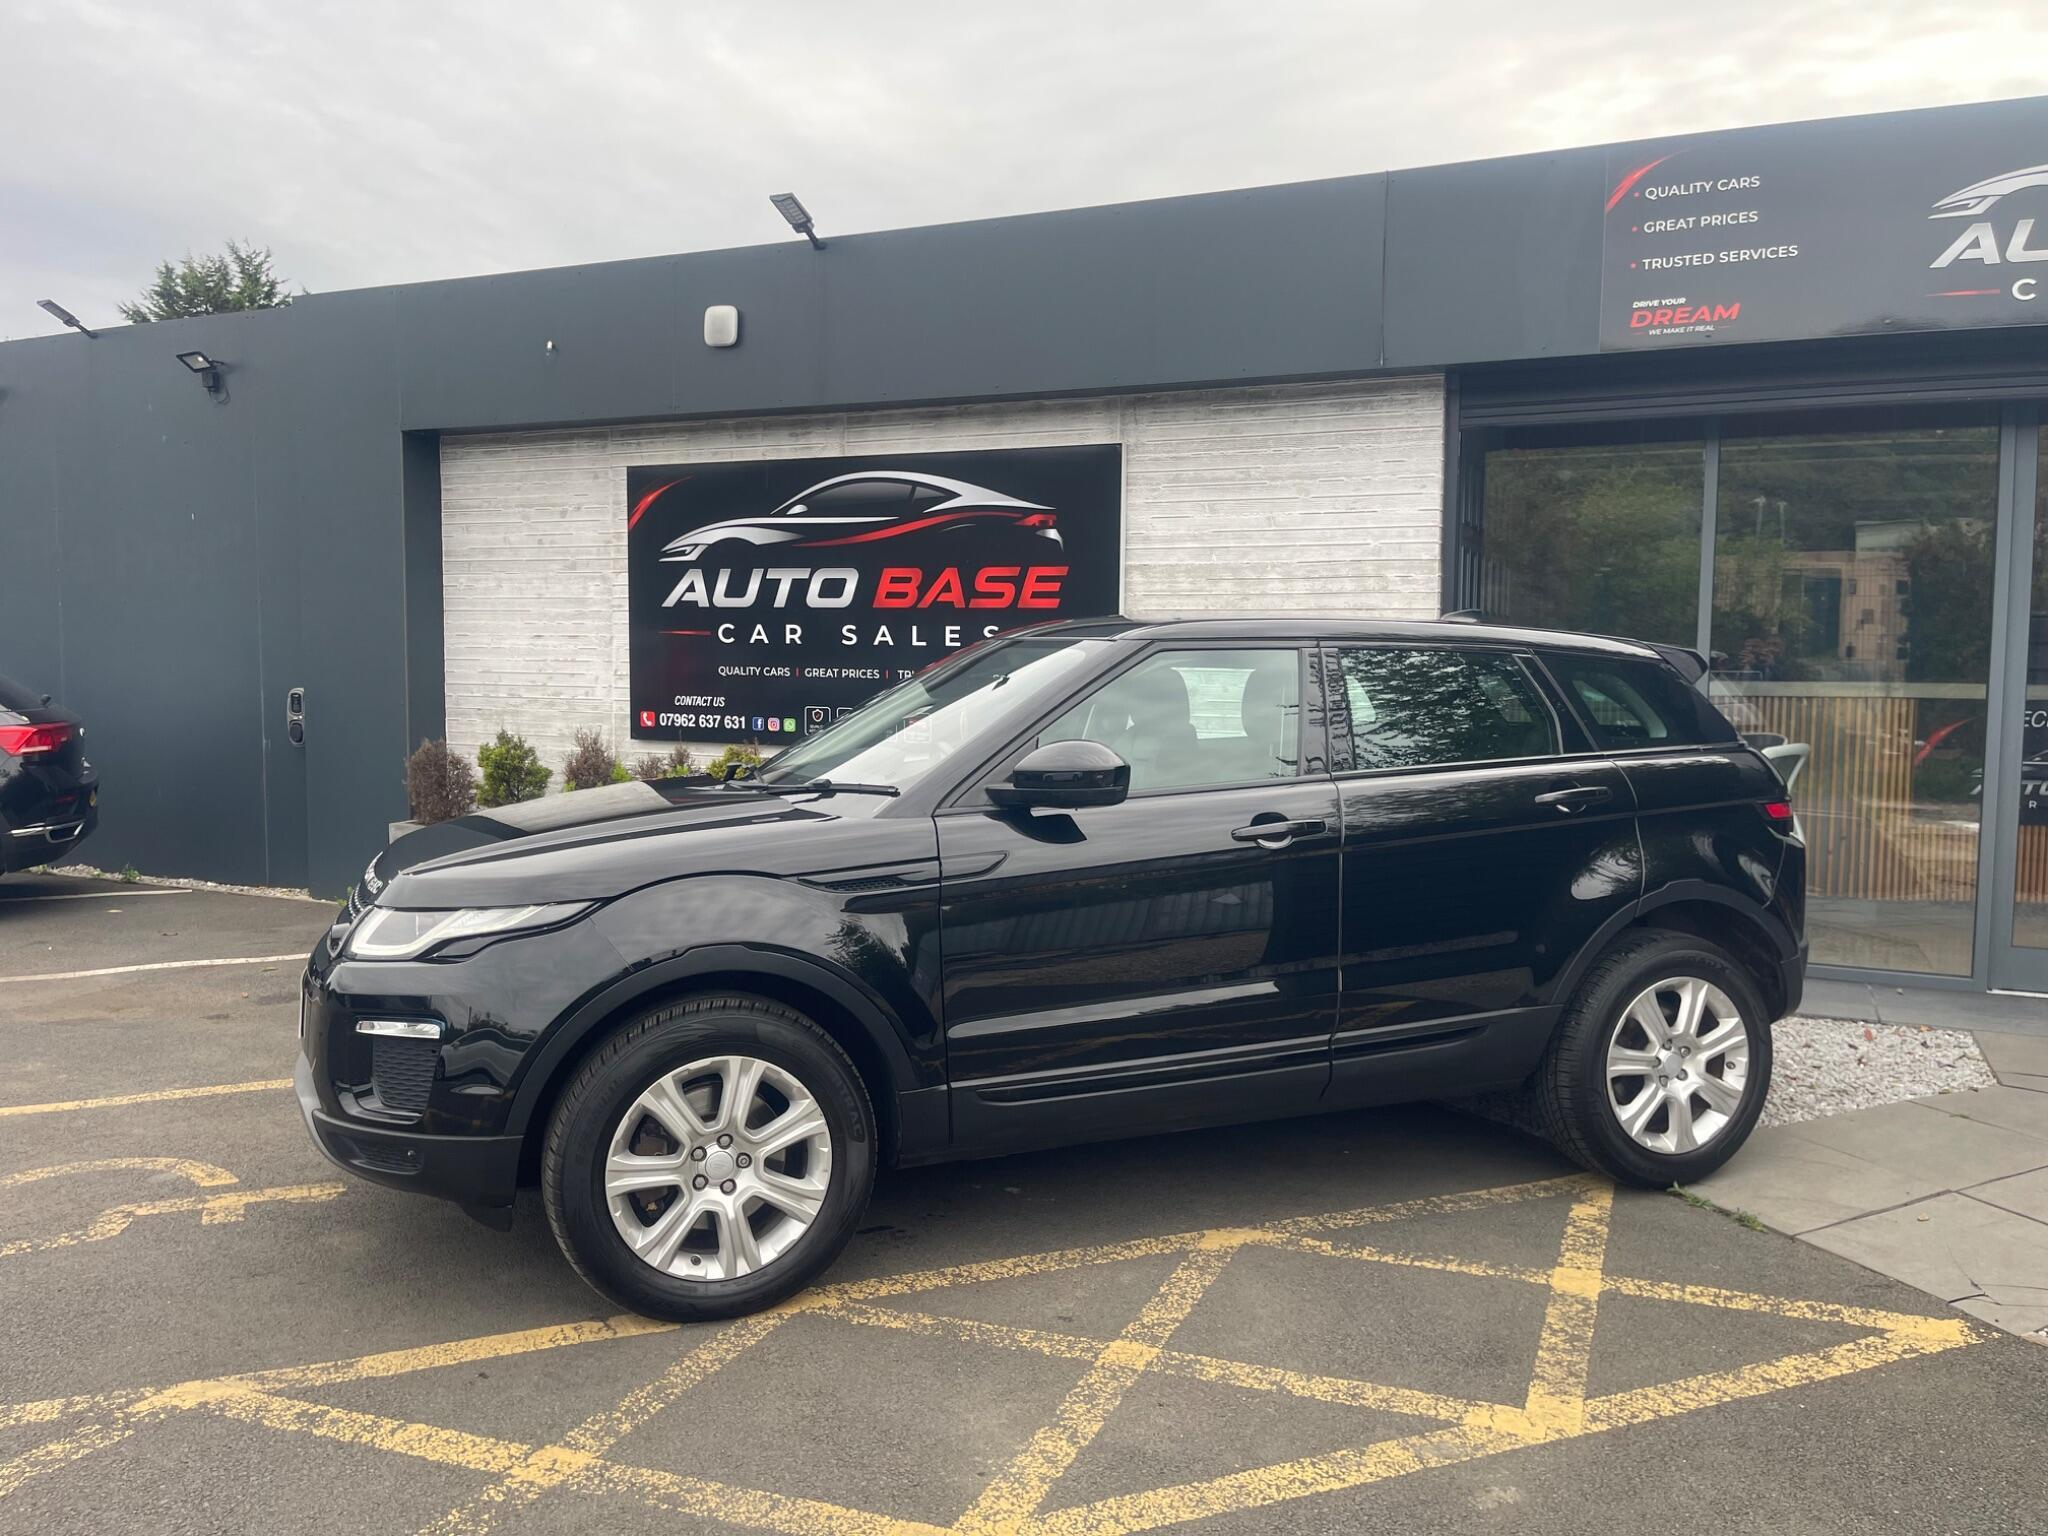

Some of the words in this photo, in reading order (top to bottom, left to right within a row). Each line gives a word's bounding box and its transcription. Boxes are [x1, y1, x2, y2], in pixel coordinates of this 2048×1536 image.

[1645, 181, 1713, 200] QUALITY
[1717, 176, 1761, 191] CARS
[1643, 217, 1696, 233] GREAT
[1700, 211, 1759, 227] PRICES
[1642, 253, 1714, 270] TRUSTED
[1719, 245, 1798, 263] SERVICES
[1632, 300, 1659, 308] DRIVE
[1661, 297, 1686, 306] YOUR
[1630, 303, 1741, 328] DREAM
[661, 567, 859, 608] AUTO
[872, 566, 1069, 609] BASE
[717, 623, 802, 644] CAR
[718, 666, 762, 676] QUALITY
[763, 667, 791, 677] CARS
[804, 667, 839, 678] GREAT
[842, 669, 880, 679] PRICES
[674, 695, 712, 707] CONTACT
[713, 697, 726, 707] US
[659, 713, 696, 727] 07962
[698, 715, 721, 728] 637
[724, 716, 746, 729] 631
